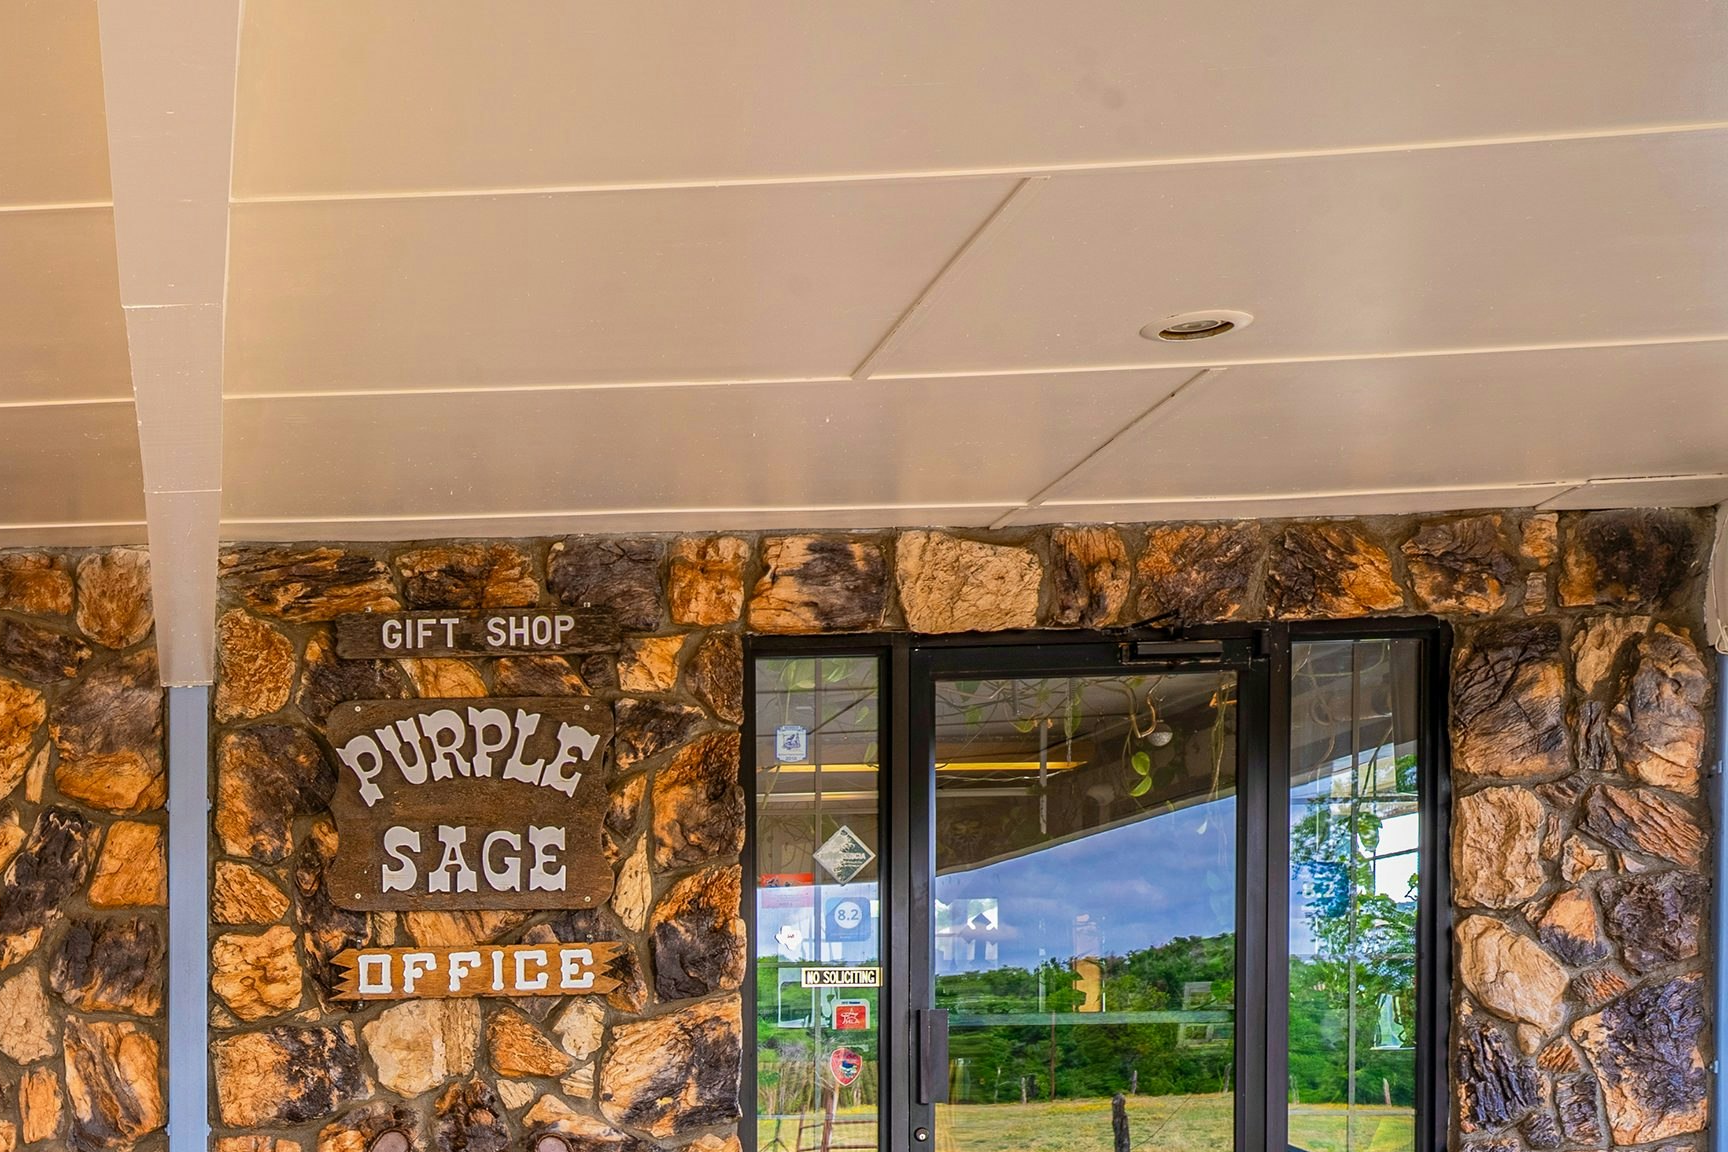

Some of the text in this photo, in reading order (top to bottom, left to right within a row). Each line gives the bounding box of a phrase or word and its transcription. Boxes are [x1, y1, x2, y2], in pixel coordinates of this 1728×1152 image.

[382, 615, 575, 649] GIFT SHOP
[336, 706, 601, 807] PURPLE
[382, 825, 567, 893] SAGE
[837, 909, 859, 921] 8.2
[358, 948, 595, 994] OFFICE
[806, 971, 875, 984] NO SOLICITING
